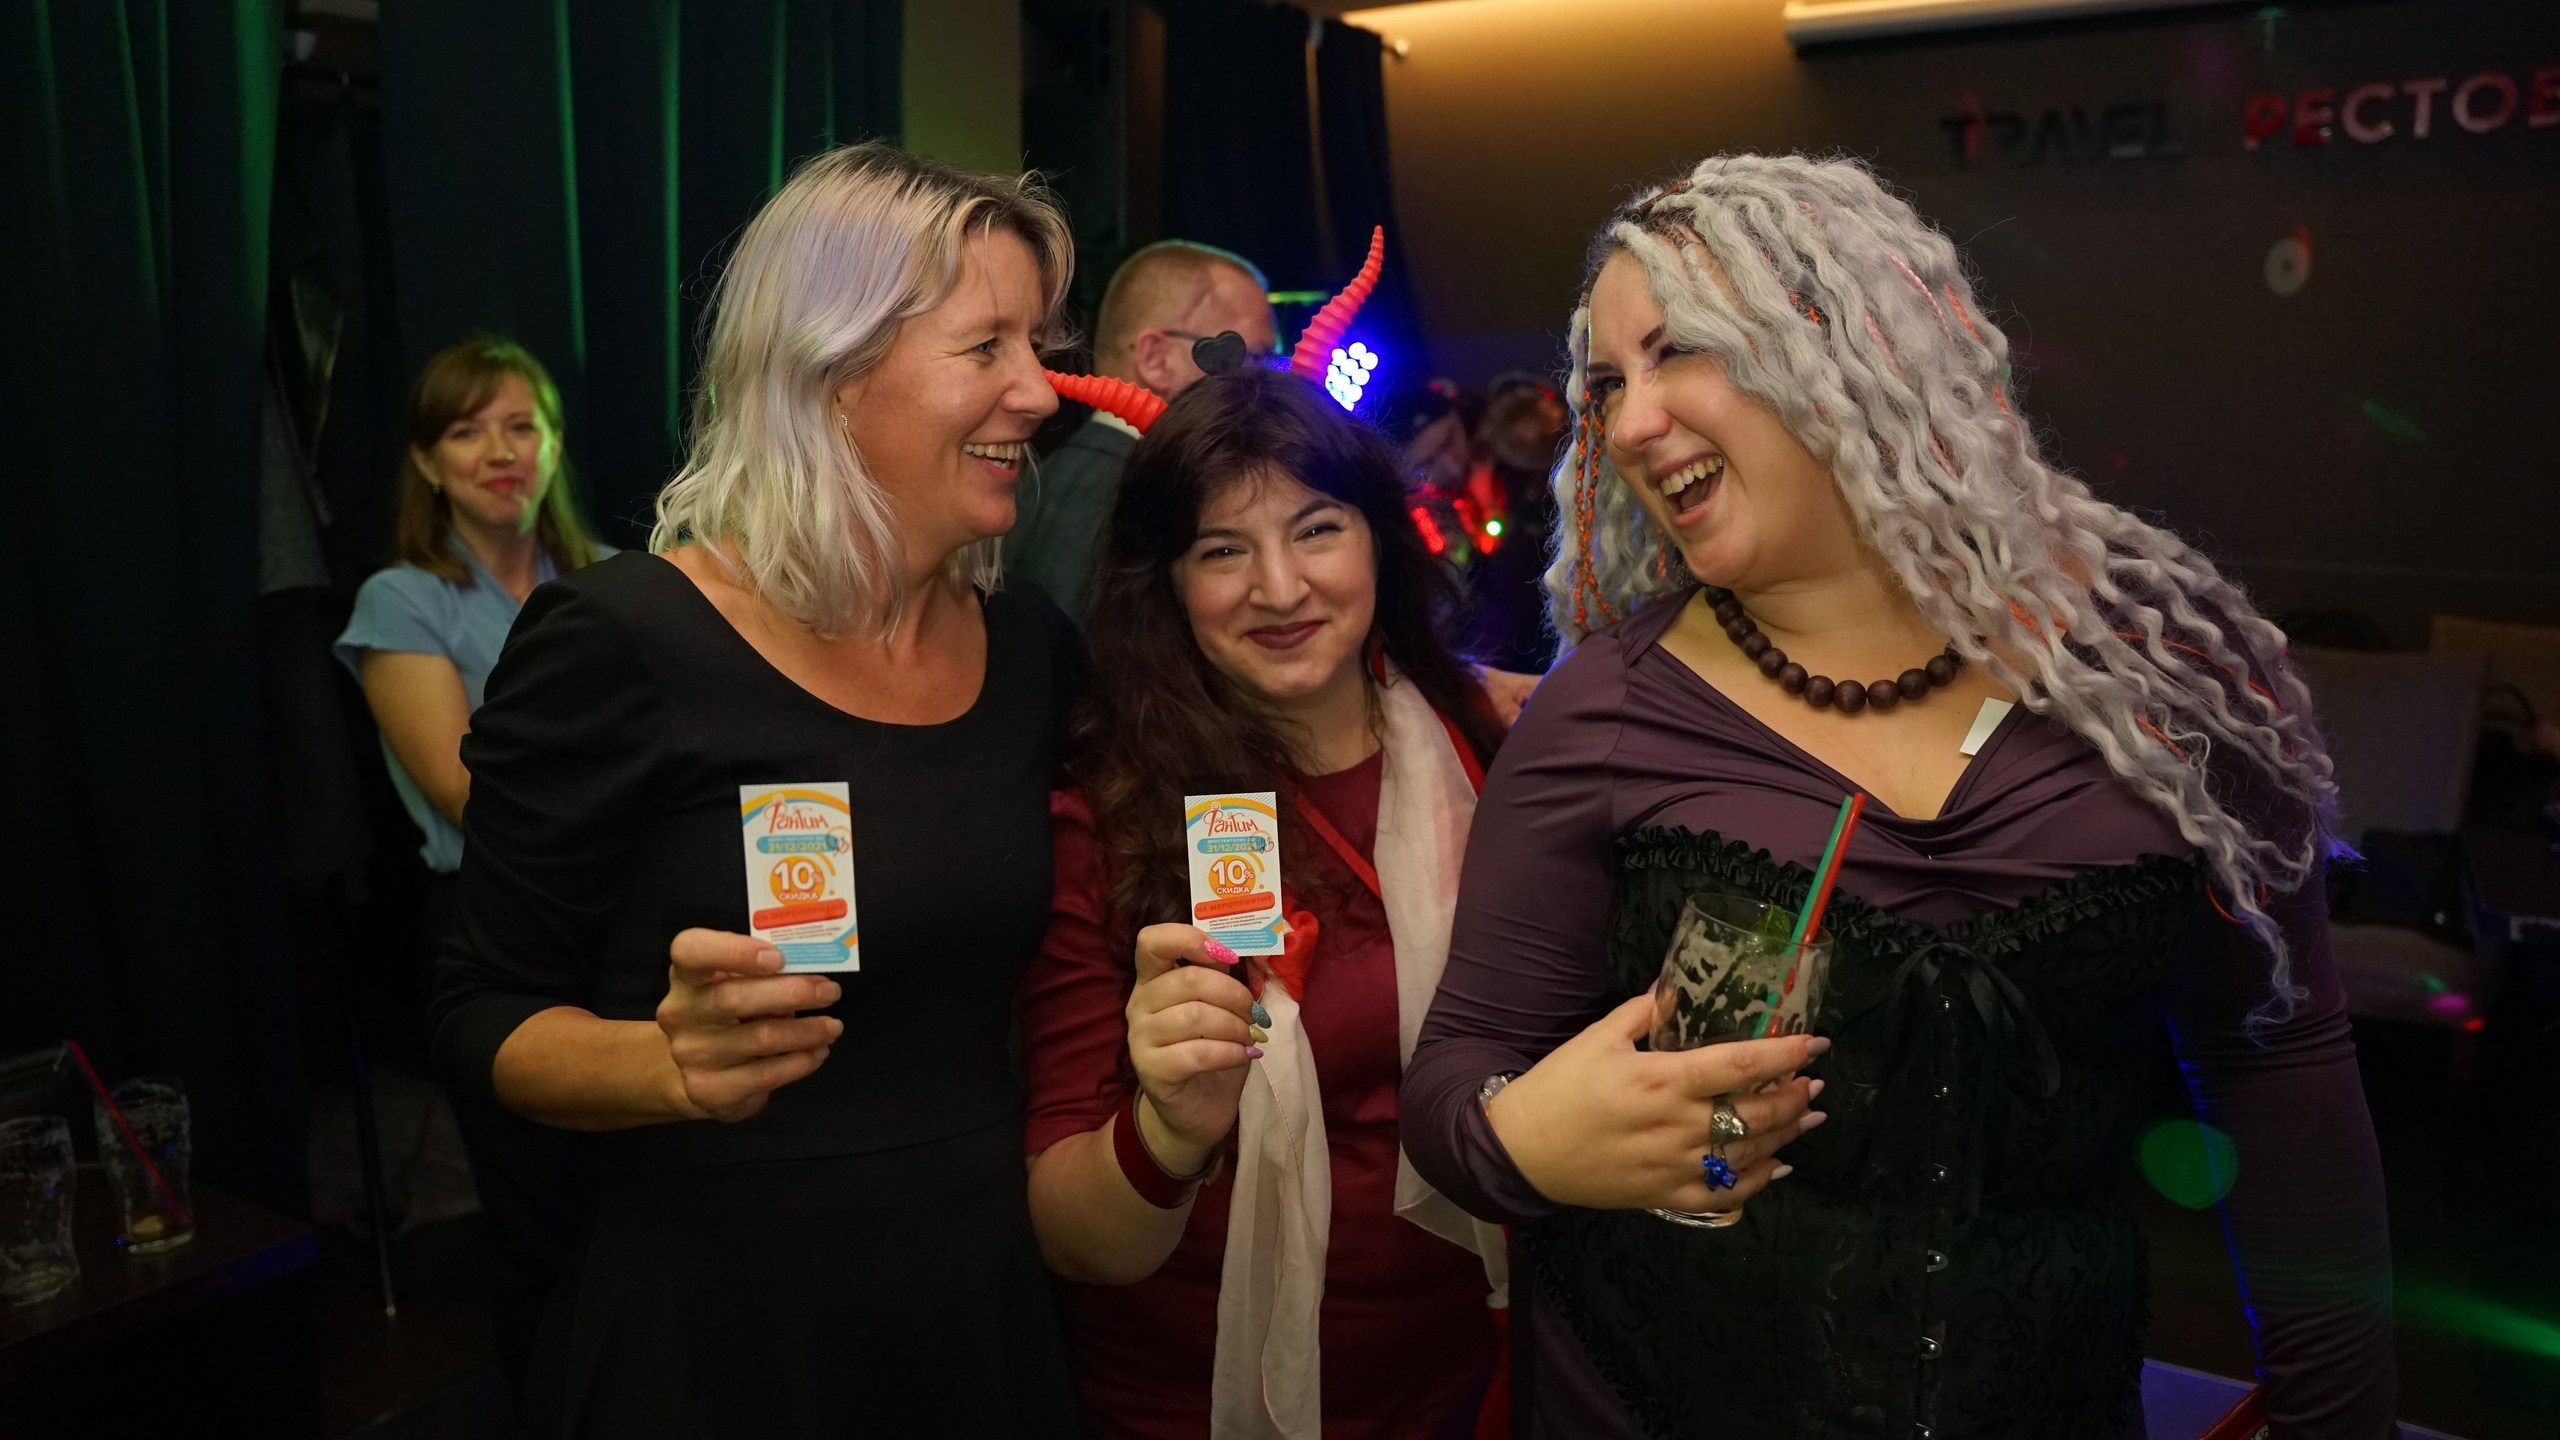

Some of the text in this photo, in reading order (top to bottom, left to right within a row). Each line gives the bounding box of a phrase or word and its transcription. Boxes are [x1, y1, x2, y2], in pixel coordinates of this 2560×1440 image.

[1207, 842, 1257, 853] 31/12/2021
[774, 860, 823, 890] 10%
[1211, 860, 1254, 885] 10%
[1216, 886, 1250, 895] СКИДКА
[779, 892, 818, 901] СКИДКА
